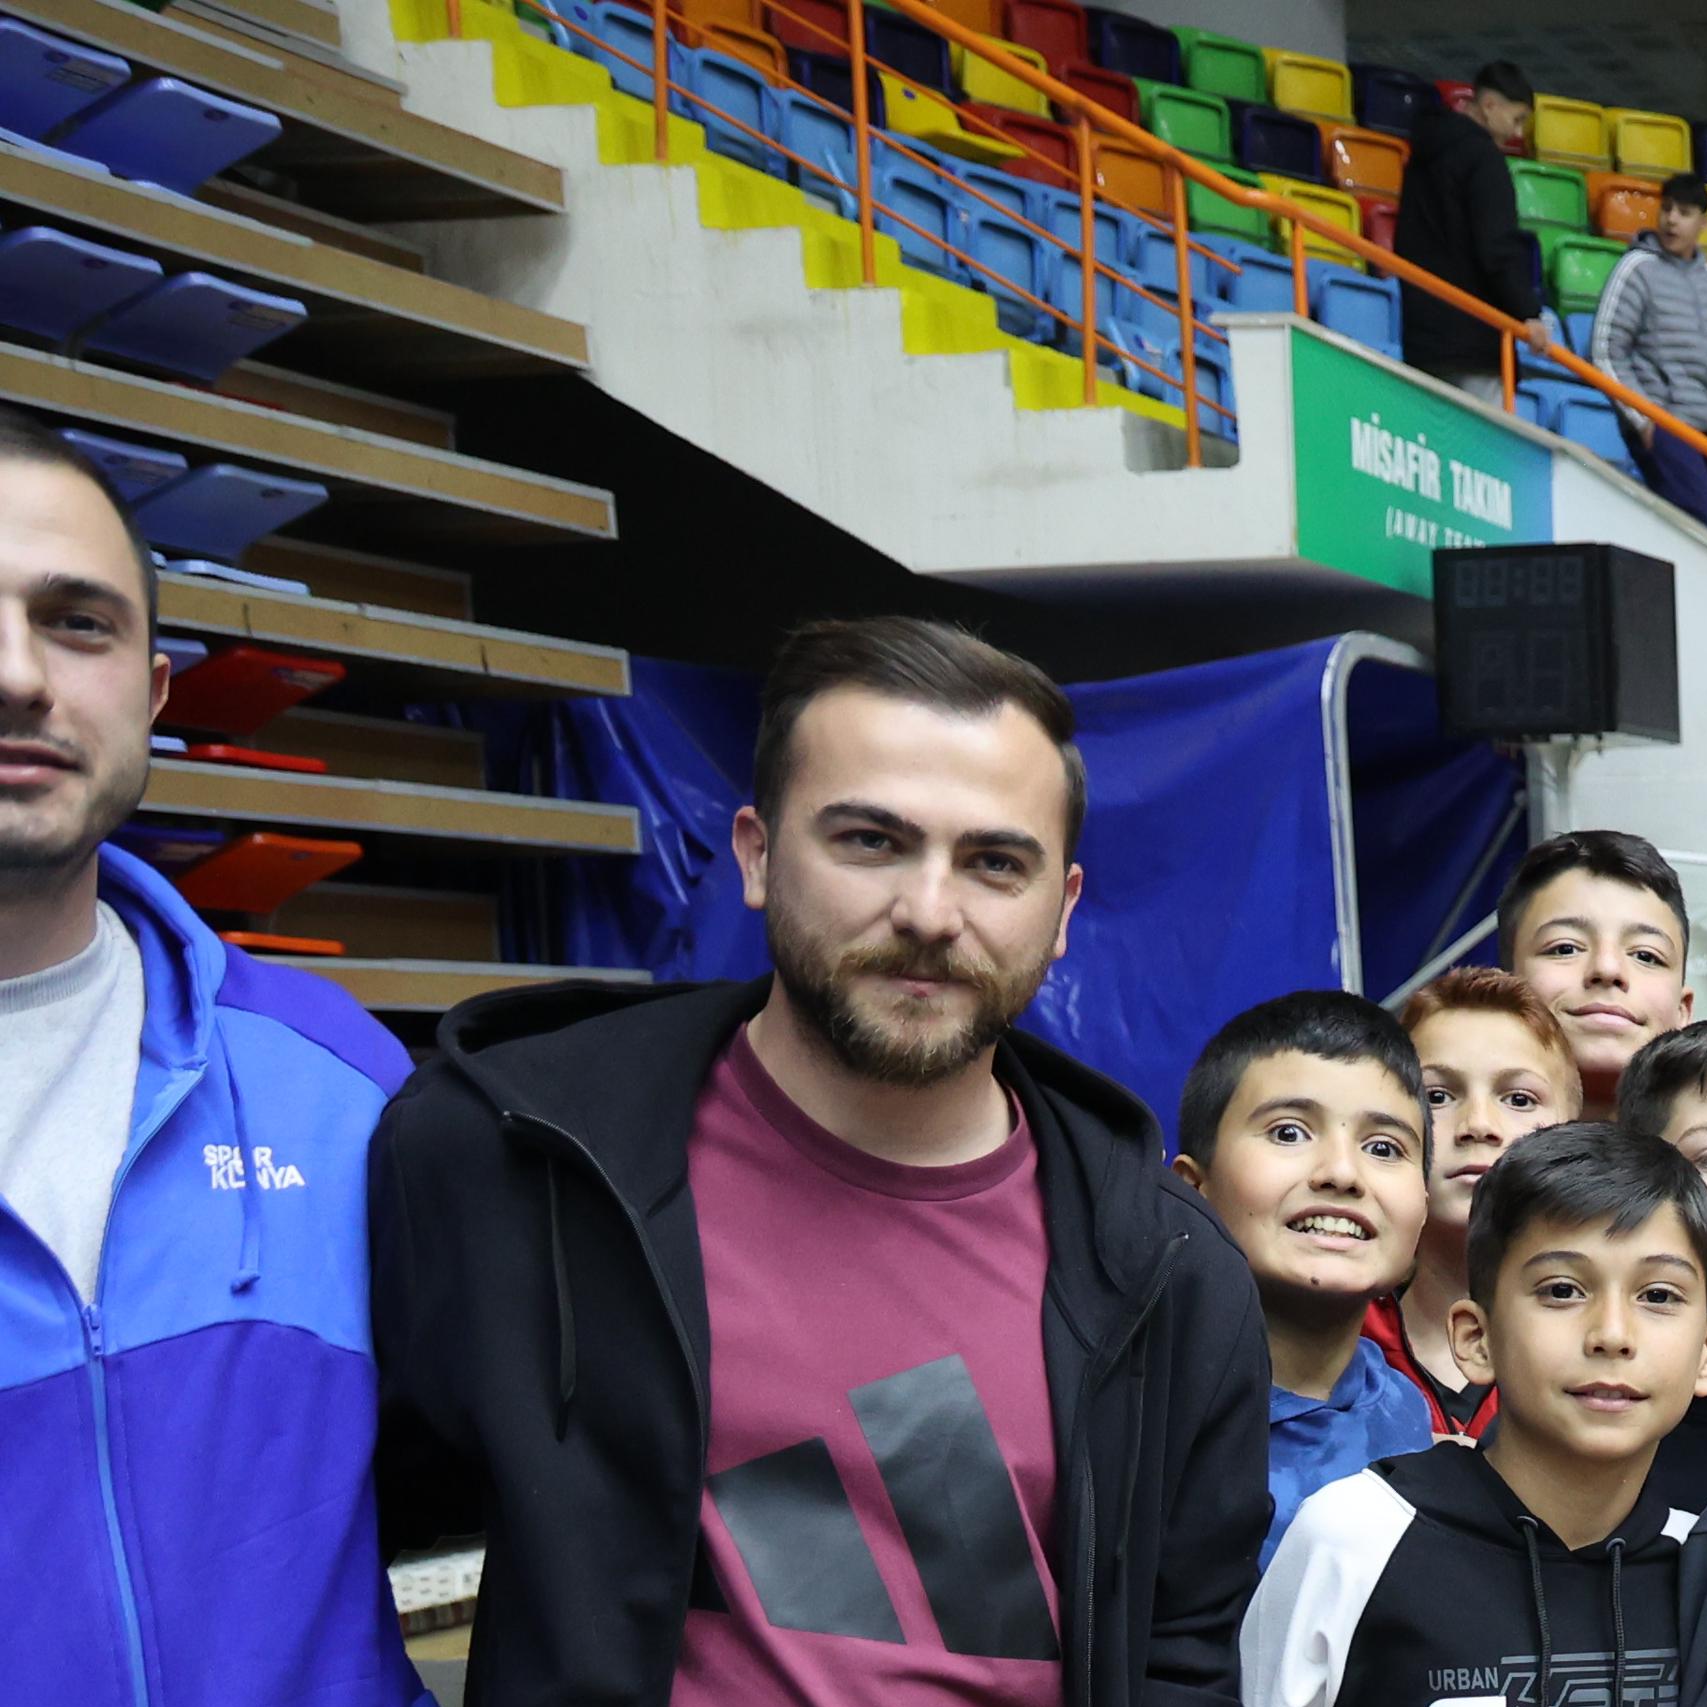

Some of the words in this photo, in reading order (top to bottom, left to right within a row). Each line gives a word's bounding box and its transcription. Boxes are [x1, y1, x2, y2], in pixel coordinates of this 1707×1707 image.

[1350, 412, 1442, 502] MİSAFİR
[1449, 459, 1513, 531] TAKIM
[1428, 1667, 1499, 1692] URBAN
